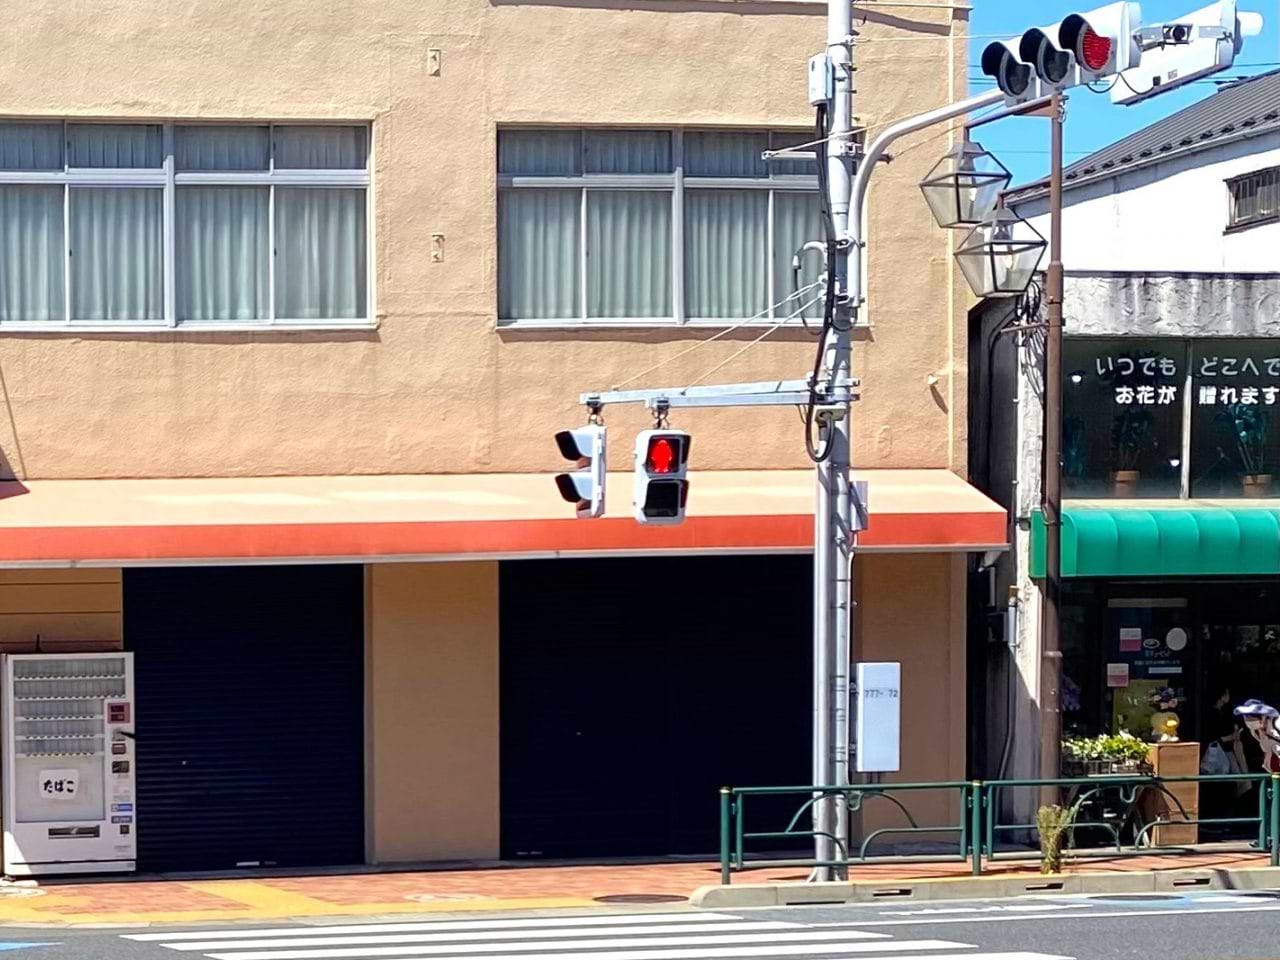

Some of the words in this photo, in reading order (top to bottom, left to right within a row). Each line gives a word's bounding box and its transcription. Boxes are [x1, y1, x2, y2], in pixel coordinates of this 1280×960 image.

[1095, 357, 1177, 376] いつでも
[1200, 357, 1280, 376] どこへで
[1114, 386, 1178, 405] お花が
[1198, 386, 1280, 405] 贈れます
[43, 779, 74, 794] たばこ
